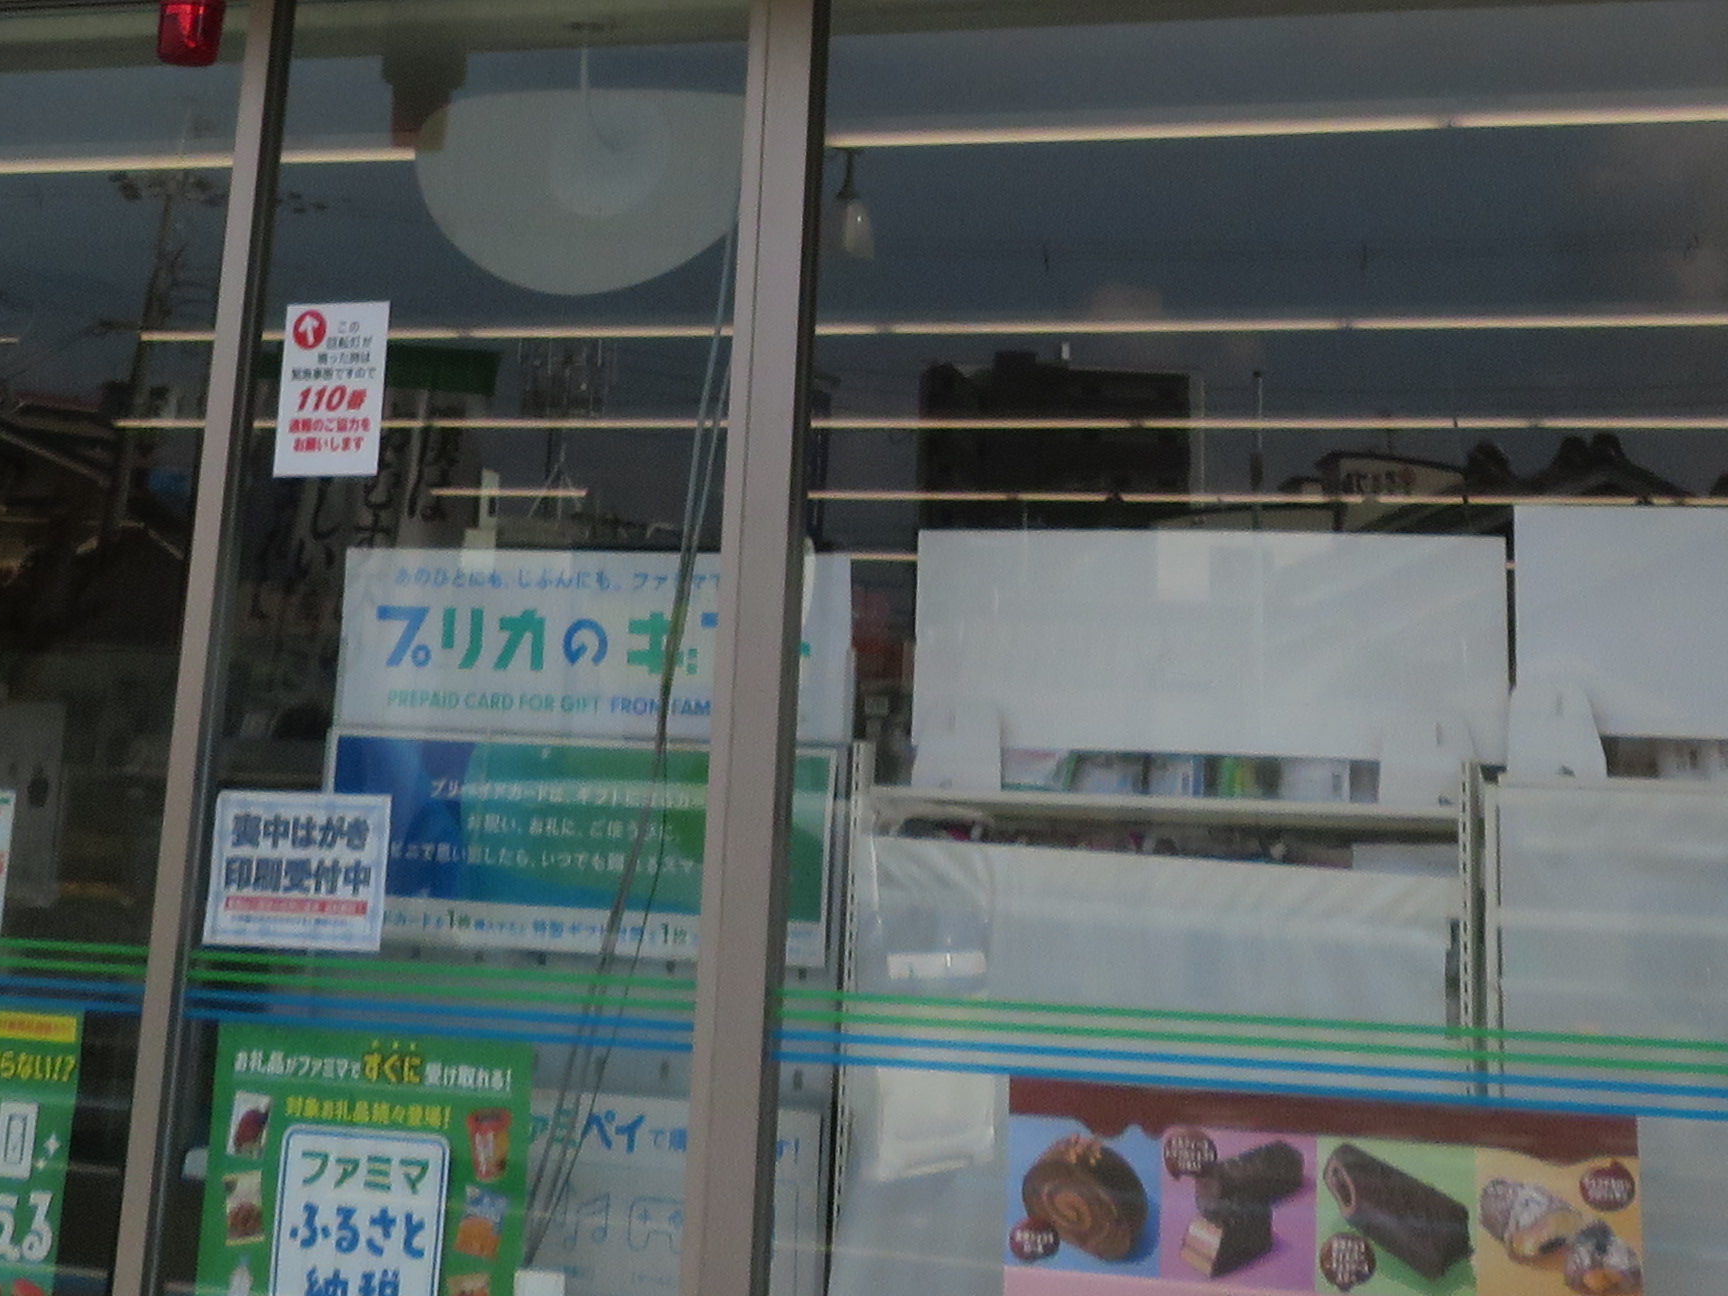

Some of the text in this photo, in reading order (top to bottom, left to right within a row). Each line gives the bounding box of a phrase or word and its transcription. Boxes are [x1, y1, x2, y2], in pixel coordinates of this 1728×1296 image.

[296, 384, 367, 411] 110番
[293, 436, 364, 452] お願いします
[464, 692, 515, 710] CARD
[519, 694, 555, 712] FOR
[224, 856, 372, 895] 印刷受付中
[301, 1151, 430, 1194] ファミマ
[289, 1201, 426, 1260] ふるさと
